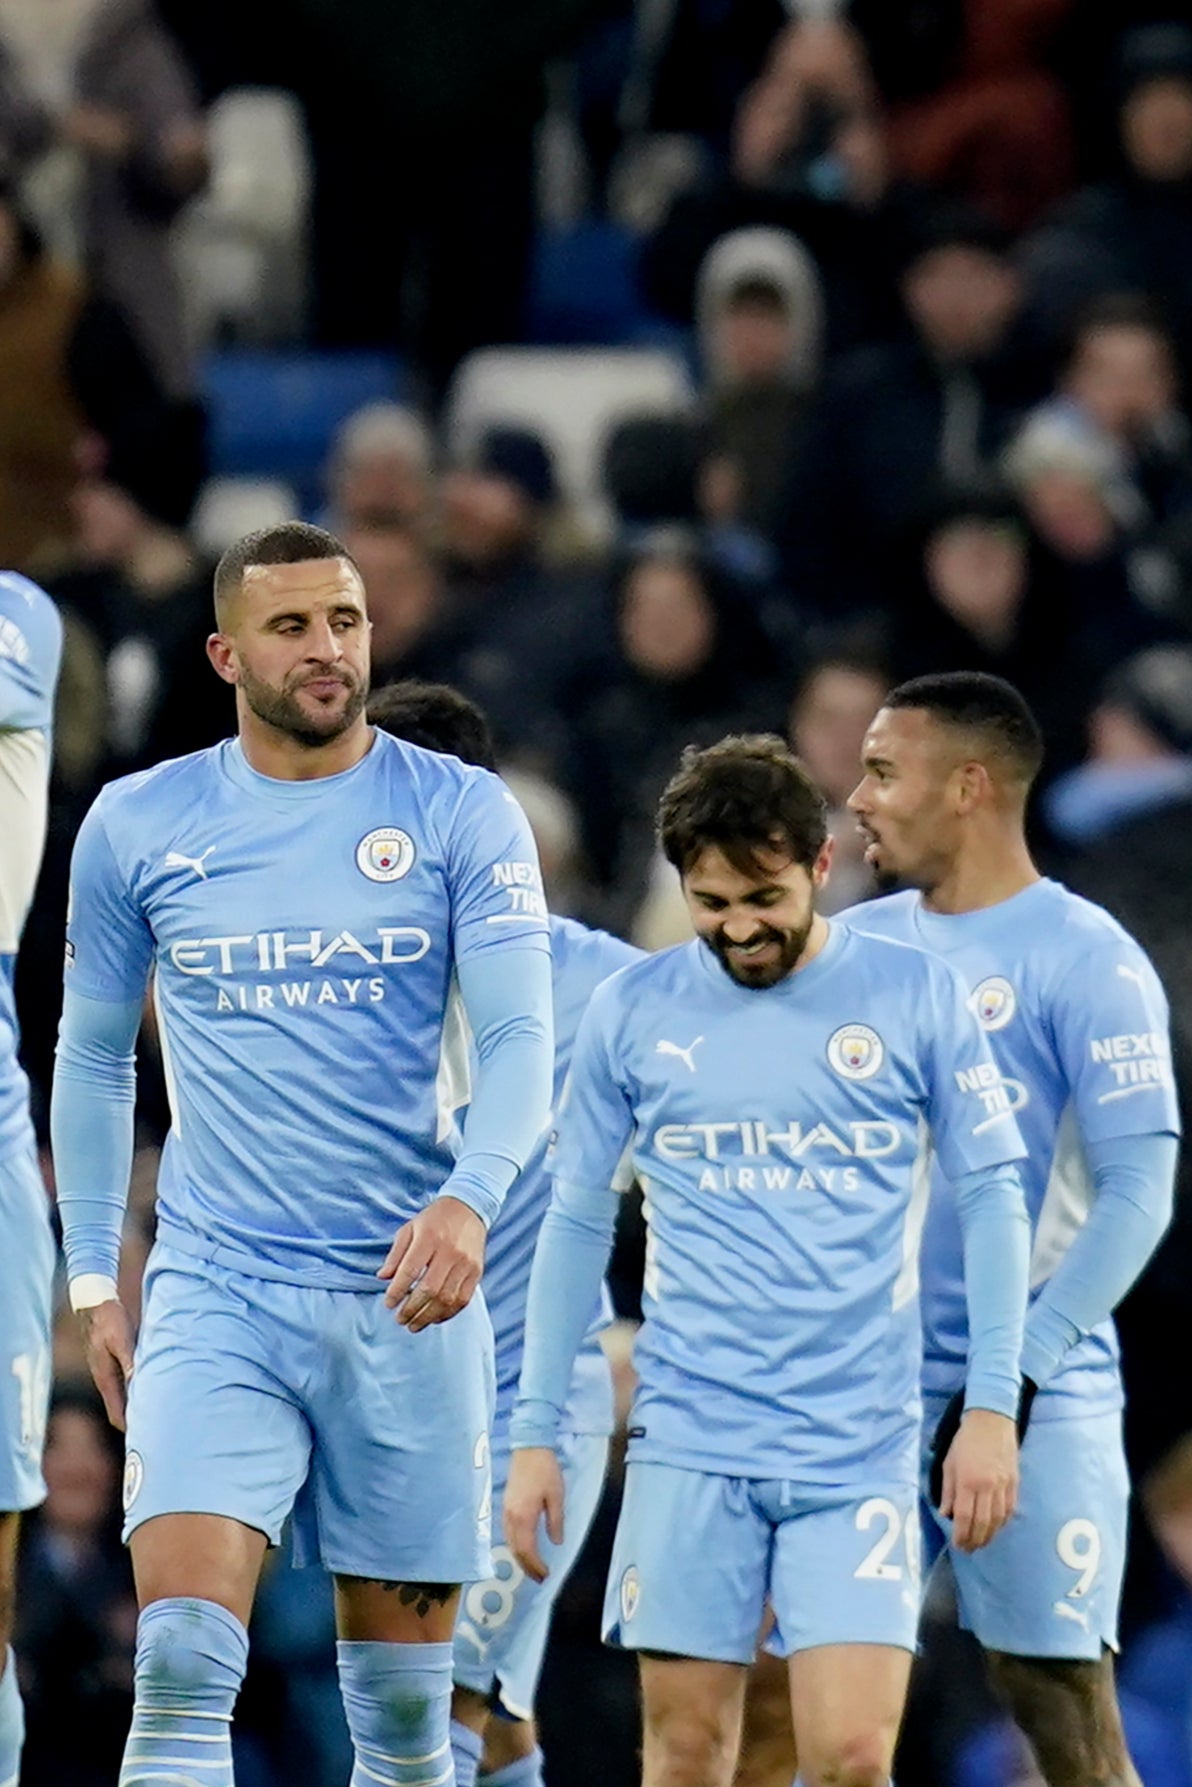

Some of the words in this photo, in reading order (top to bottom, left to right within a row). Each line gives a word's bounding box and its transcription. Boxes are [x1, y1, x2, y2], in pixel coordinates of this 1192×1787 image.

[170, 926, 431, 976] ETIHAD
[216, 978, 385, 1011] AIRWAYS
[653, 1121, 901, 1159] ETIHAD
[699, 1167, 860, 1191] AIRWAYS
[1056, 1518, 1101, 1598] 9
[466, 1545, 525, 1629] 8
